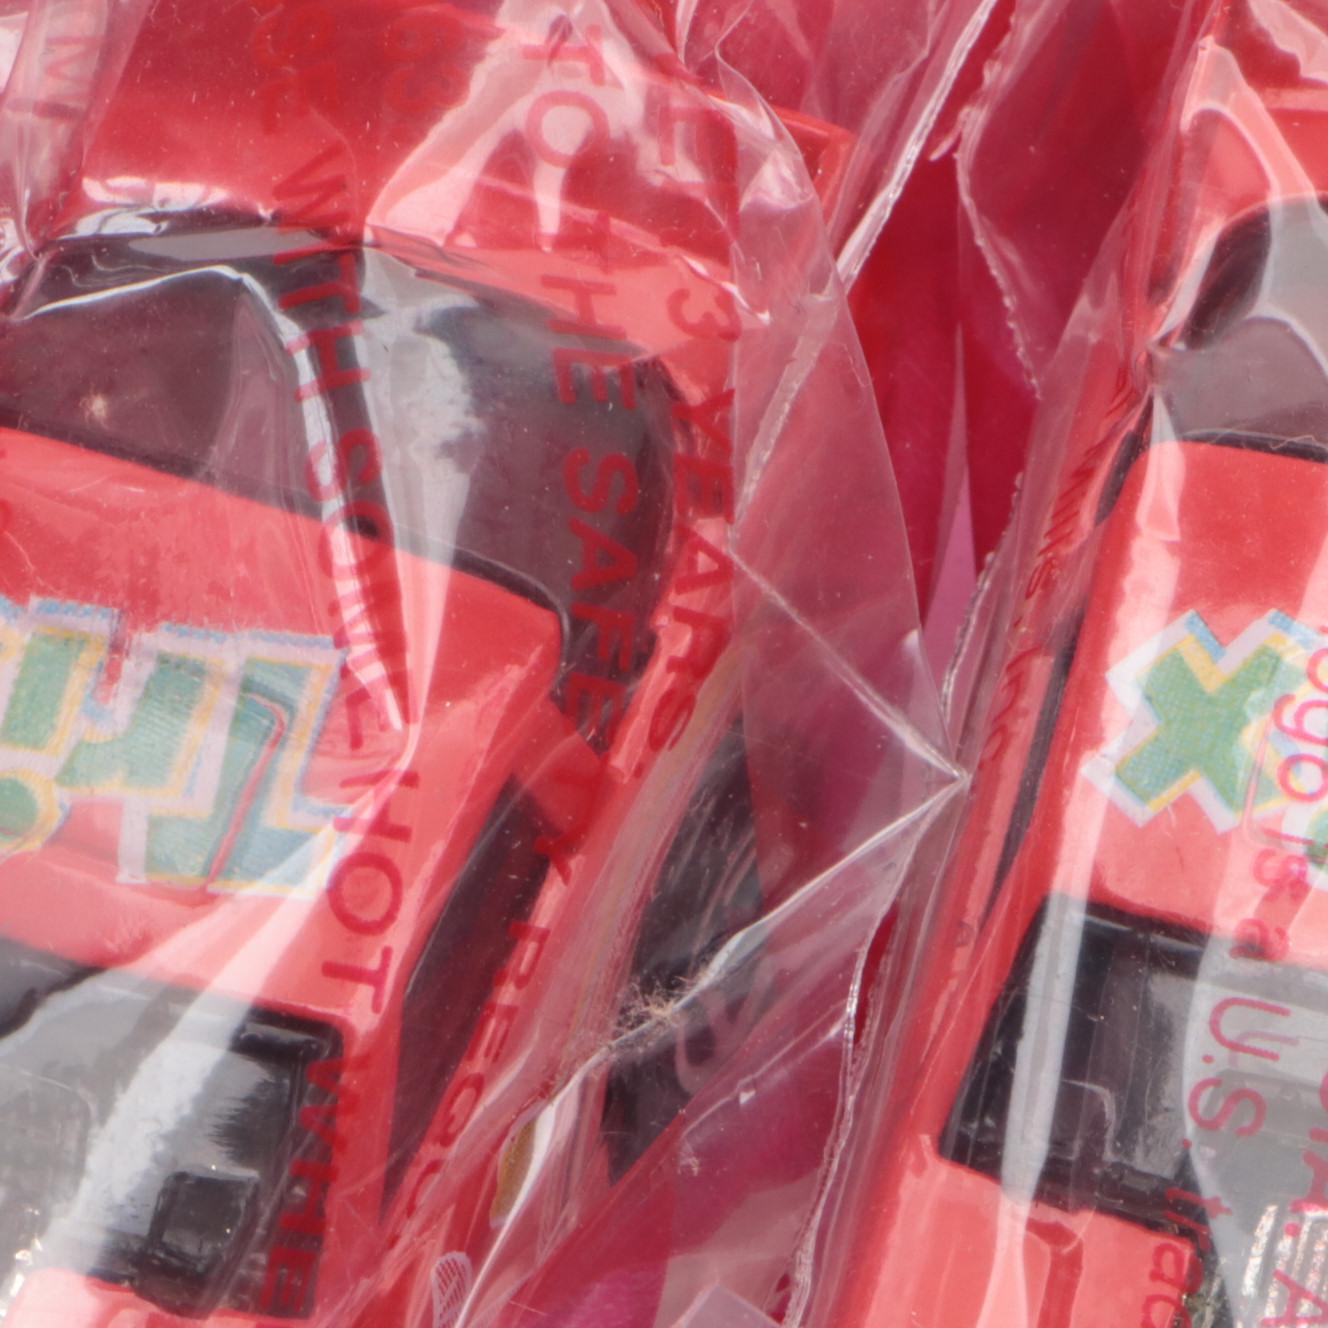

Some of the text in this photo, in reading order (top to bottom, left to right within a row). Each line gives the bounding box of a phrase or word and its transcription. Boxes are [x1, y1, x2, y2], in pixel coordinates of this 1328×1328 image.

[272, 148, 369, 402] WITH
[538, 210, 638, 411] THE
[305, 438, 416, 749] SOME
[324, 770, 420, 1016] HOT
[1183, 997, 1295, 1147] U.S.
